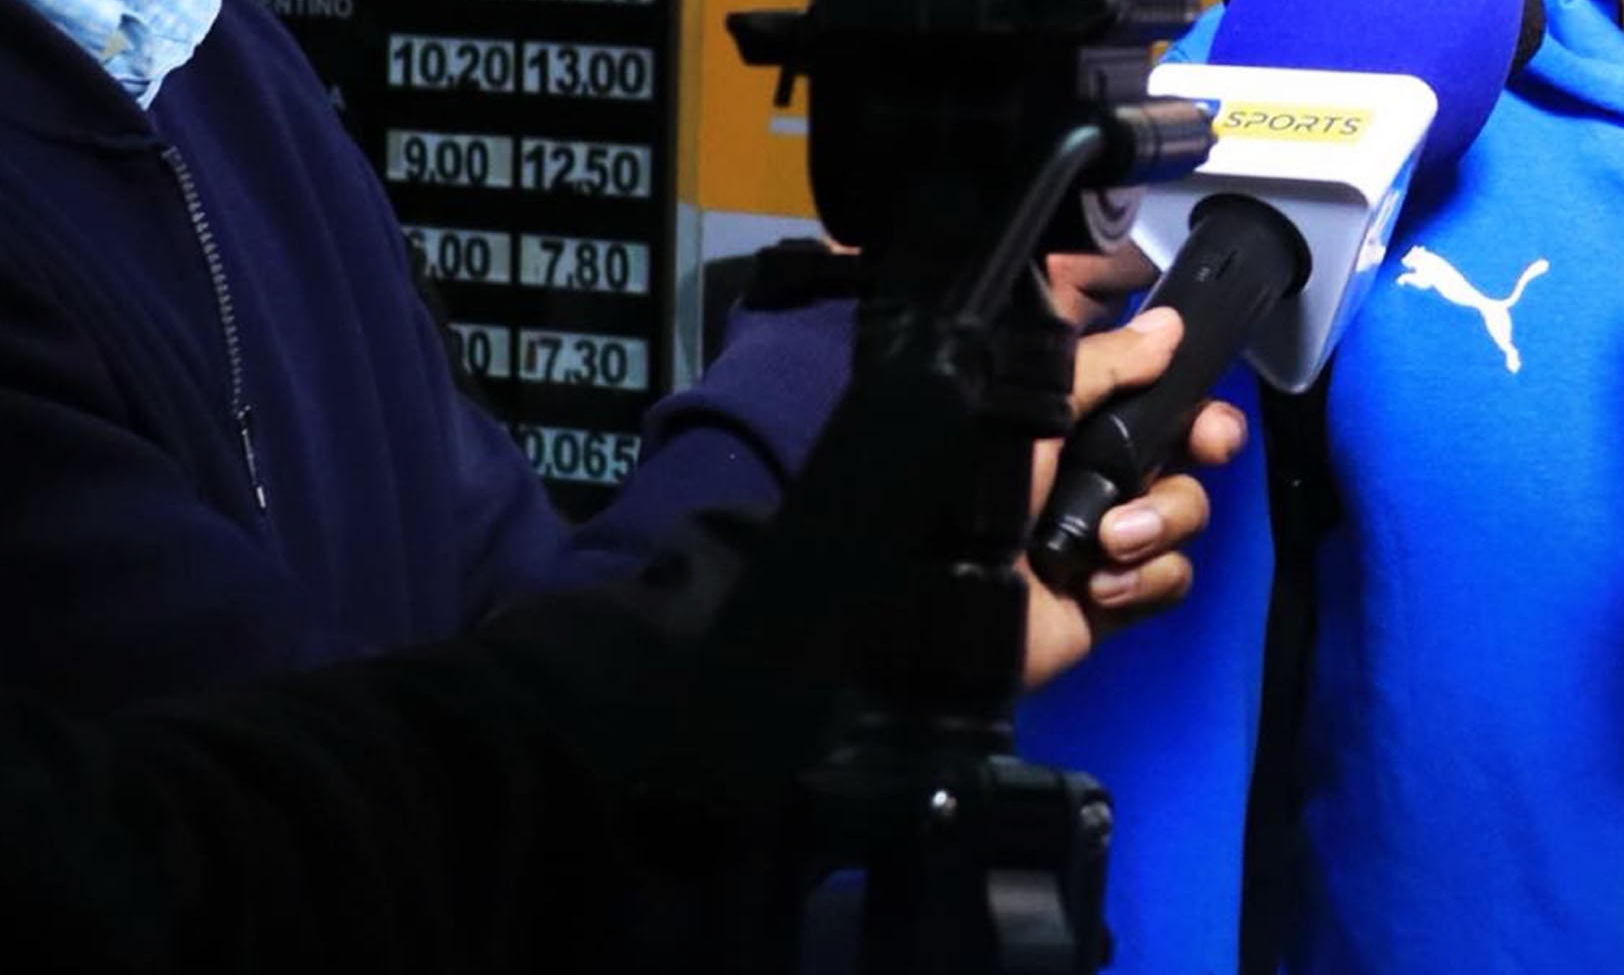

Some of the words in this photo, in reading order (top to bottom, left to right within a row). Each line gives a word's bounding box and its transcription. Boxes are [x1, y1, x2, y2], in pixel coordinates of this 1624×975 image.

[394, 37, 511, 90] 10,20
[529, 46, 648, 97] 13,00
[1222, 110, 1363, 136] SPORTS
[404, 136, 490, 184] 9,00
[524, 143, 640, 193] 12,50
[540, 240, 628, 291] 7,80
